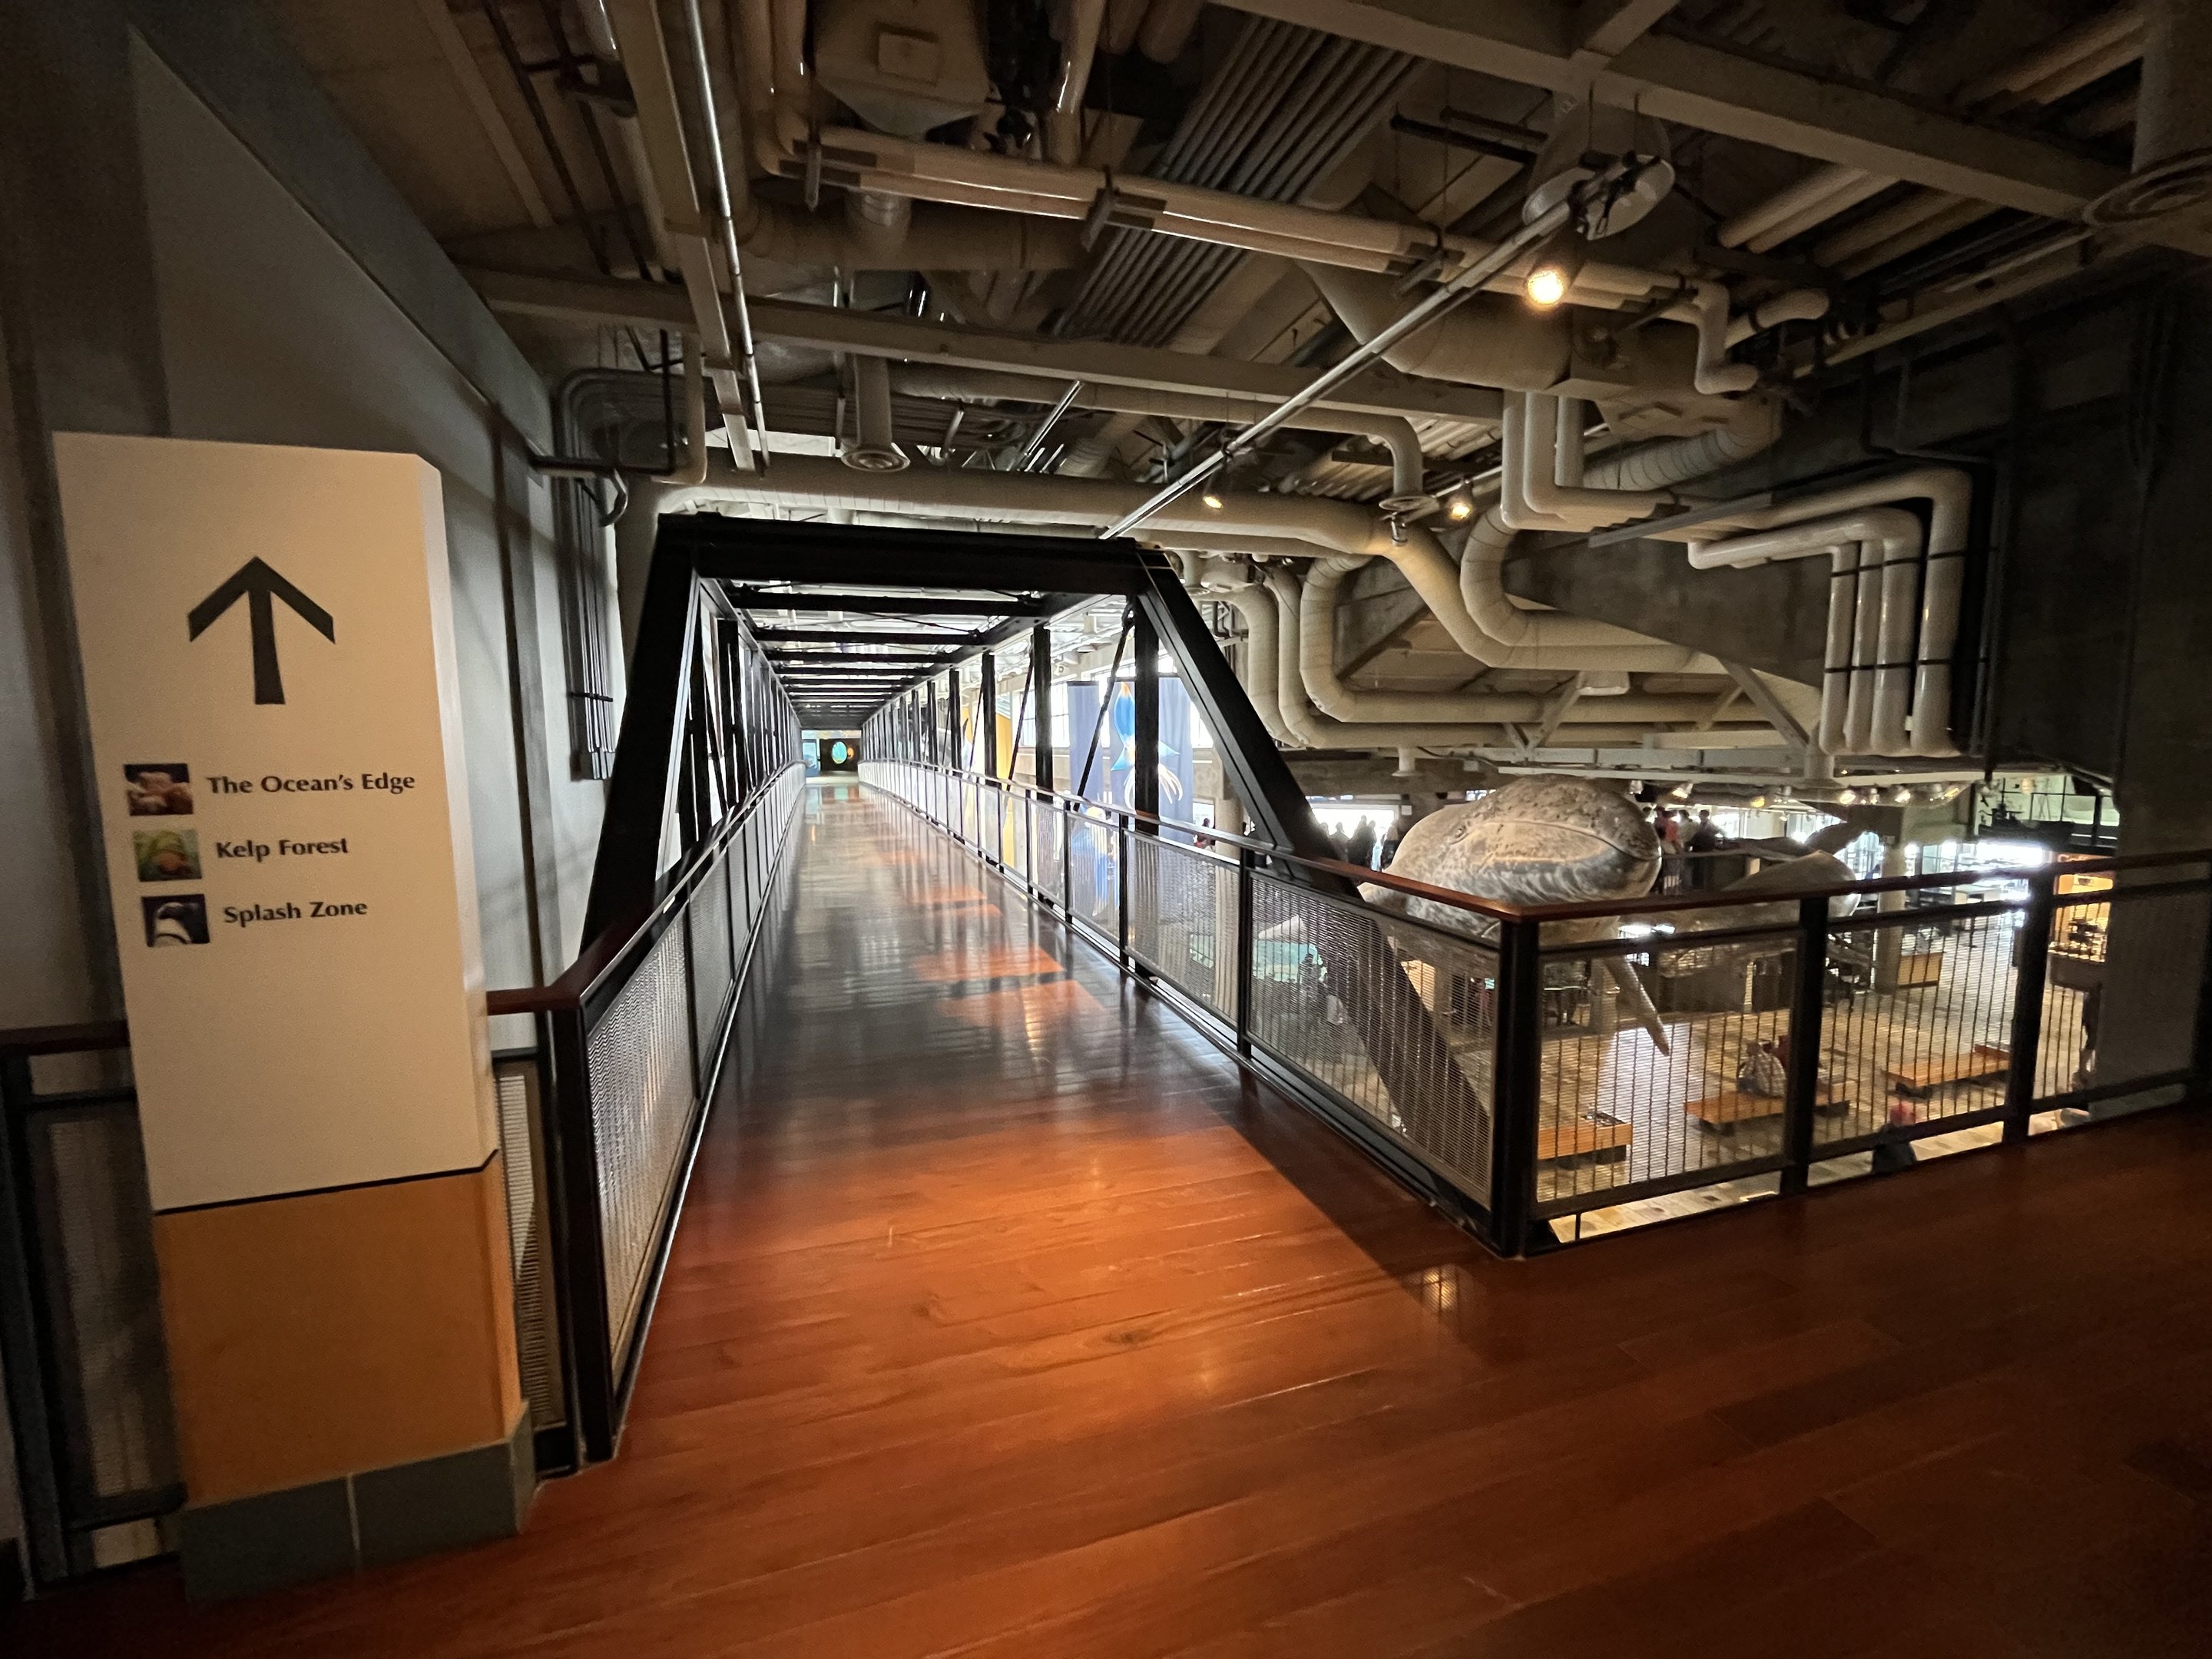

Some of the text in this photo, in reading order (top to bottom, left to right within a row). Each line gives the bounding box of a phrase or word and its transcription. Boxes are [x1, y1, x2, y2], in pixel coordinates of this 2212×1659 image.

[206, 771, 416, 795] The Ocean's Edge
[216, 838, 349, 863] Kelp Forest
[223, 901, 369, 929] Splash Zone
